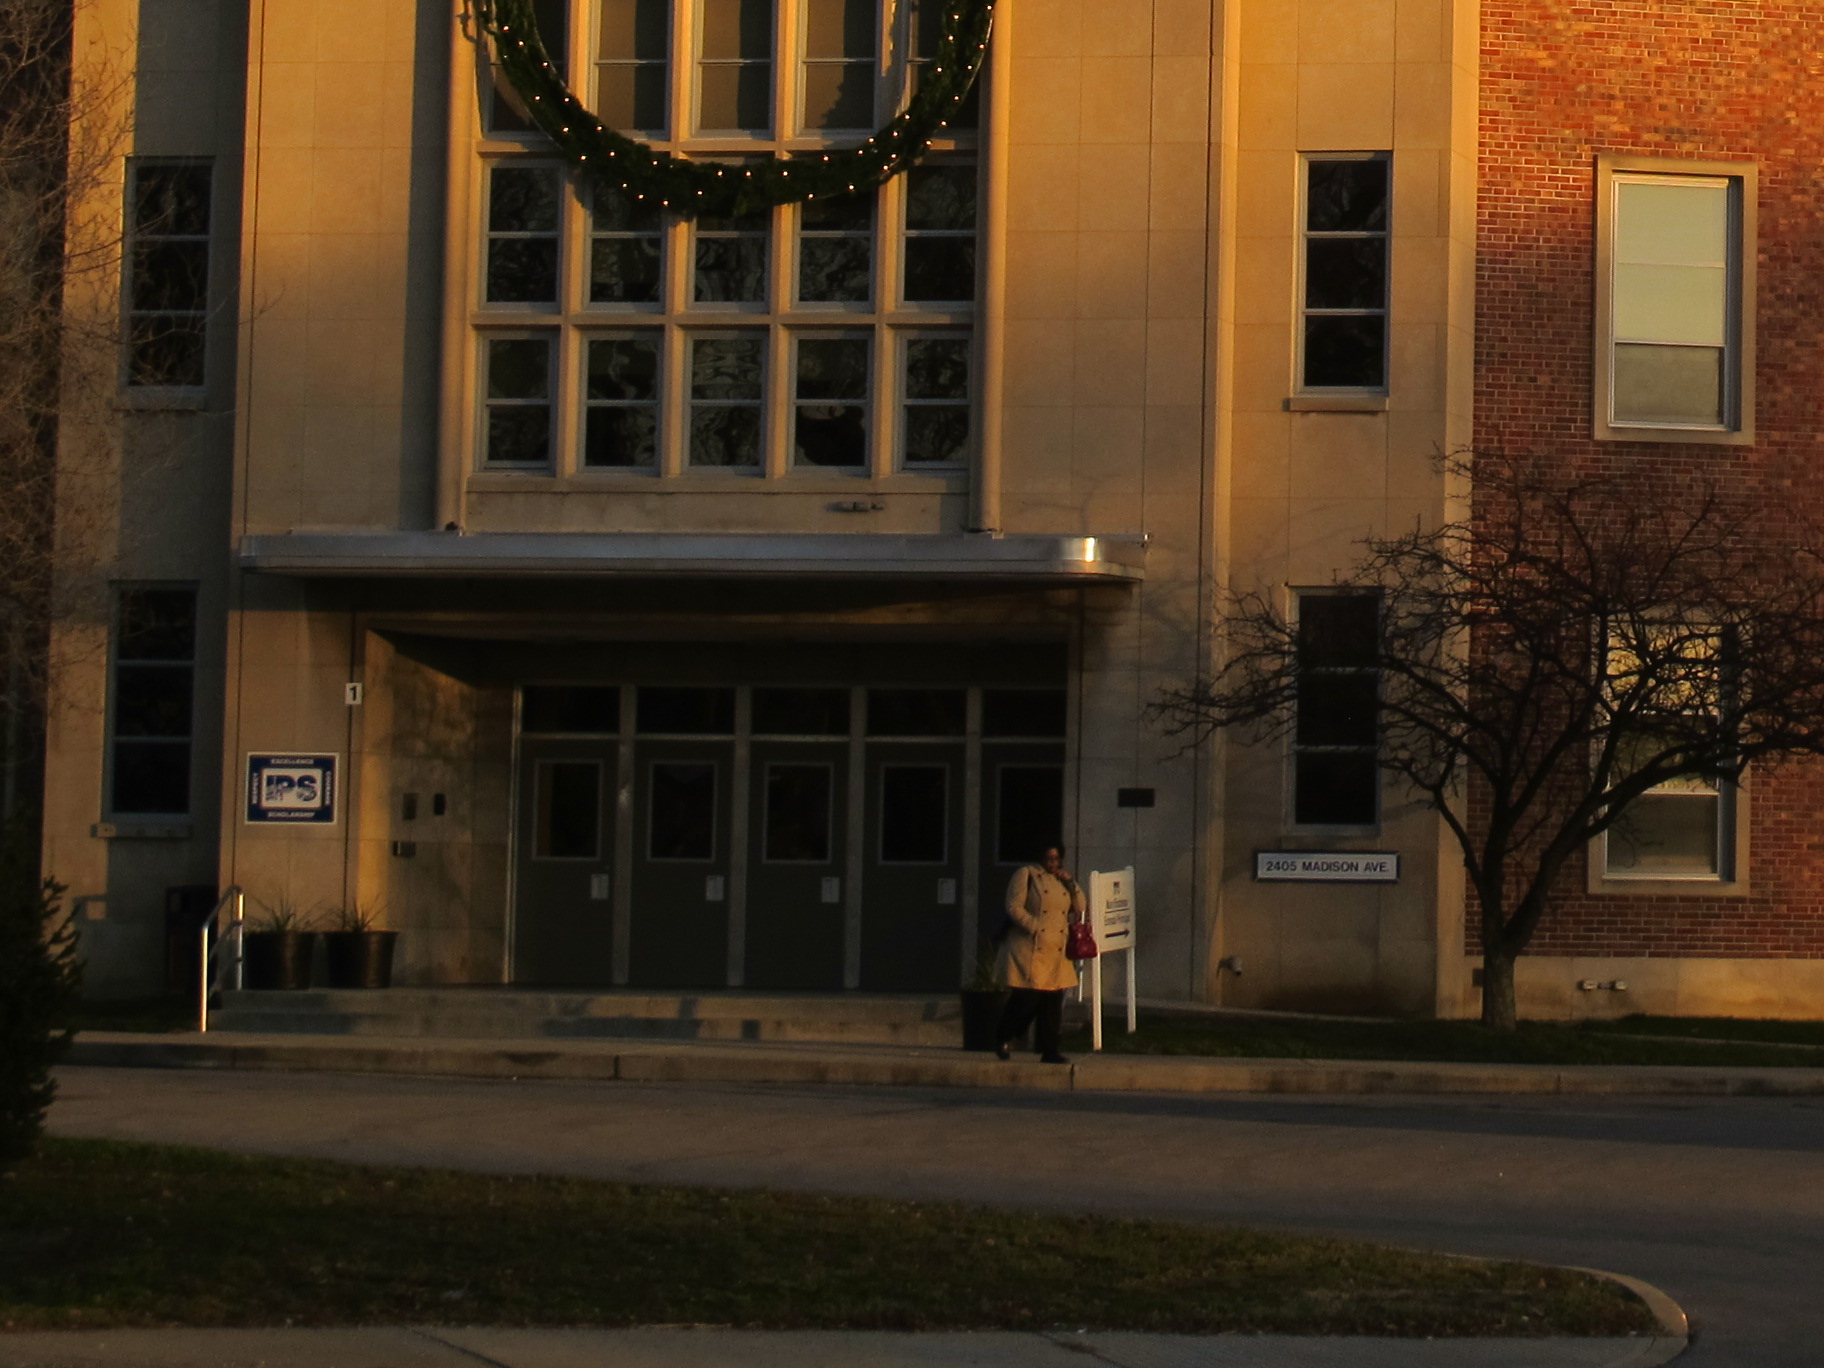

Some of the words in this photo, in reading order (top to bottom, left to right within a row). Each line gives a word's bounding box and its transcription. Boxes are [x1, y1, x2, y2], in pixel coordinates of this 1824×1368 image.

[350, 686, 357, 701] 1
[266, 775, 317, 802] IPS
[1266, 860, 1297, 872] 2405
[1302, 860, 1359, 873] MADISON
